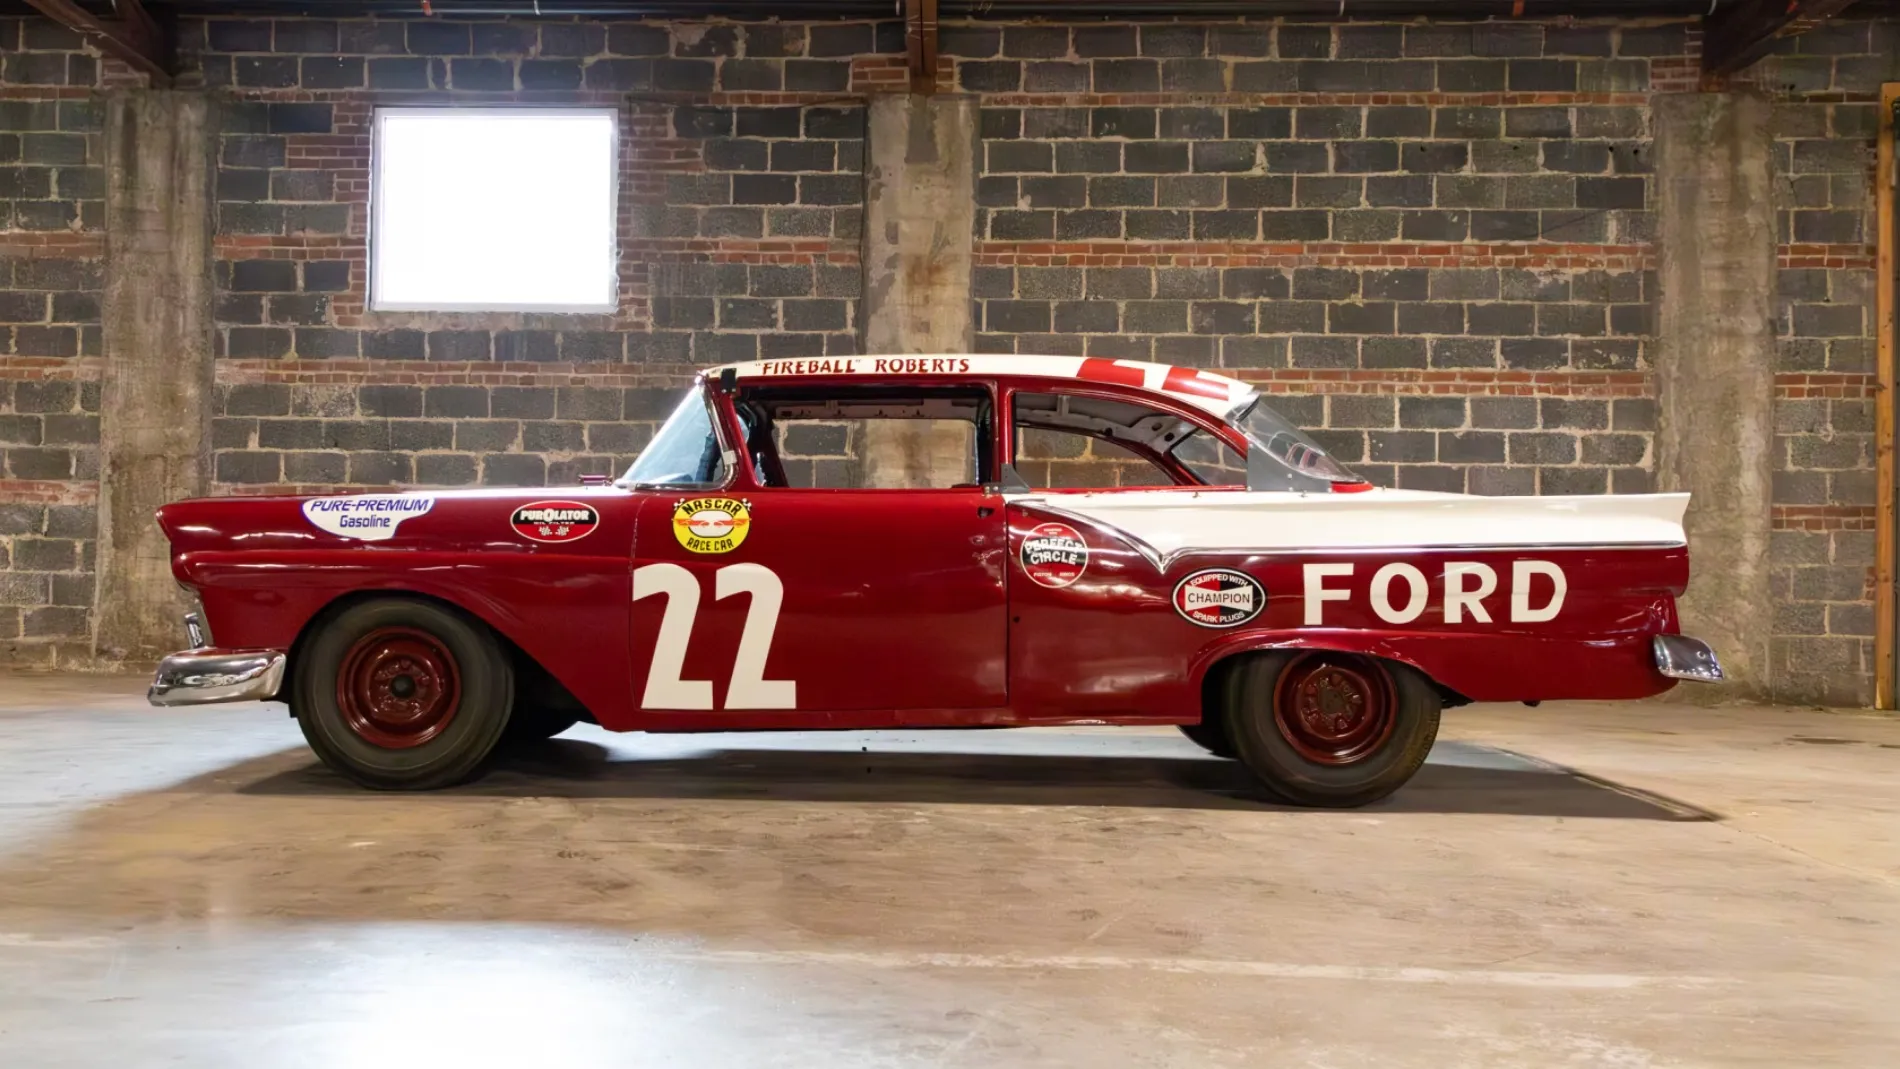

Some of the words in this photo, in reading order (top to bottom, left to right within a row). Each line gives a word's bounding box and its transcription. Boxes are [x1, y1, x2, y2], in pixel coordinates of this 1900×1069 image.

[874, 358, 969, 373] ROBERTS
[310, 499, 429, 511] PURE-PREMIUM
[682, 499, 742, 516] NASCAR
[339, 514, 391, 527] Gasoline
[520, 508, 590, 522] PUROLATOR
[686, 537, 711, 551] RACE
[714, 538, 734, 551] CAR
[1031, 551, 1078, 565] CIRCLE
[1190, 573, 1228, 587] EQUIPPED
[1229, 574, 1248, 587] WITH
[1187, 592, 1250, 603] CHAMPION
[1303, 560, 1568, 626] FORD
[1192, 610, 1218, 623] SPARK
[1219, 611, 1245, 623] PLUGS
[632, 562, 796, 710] 22
